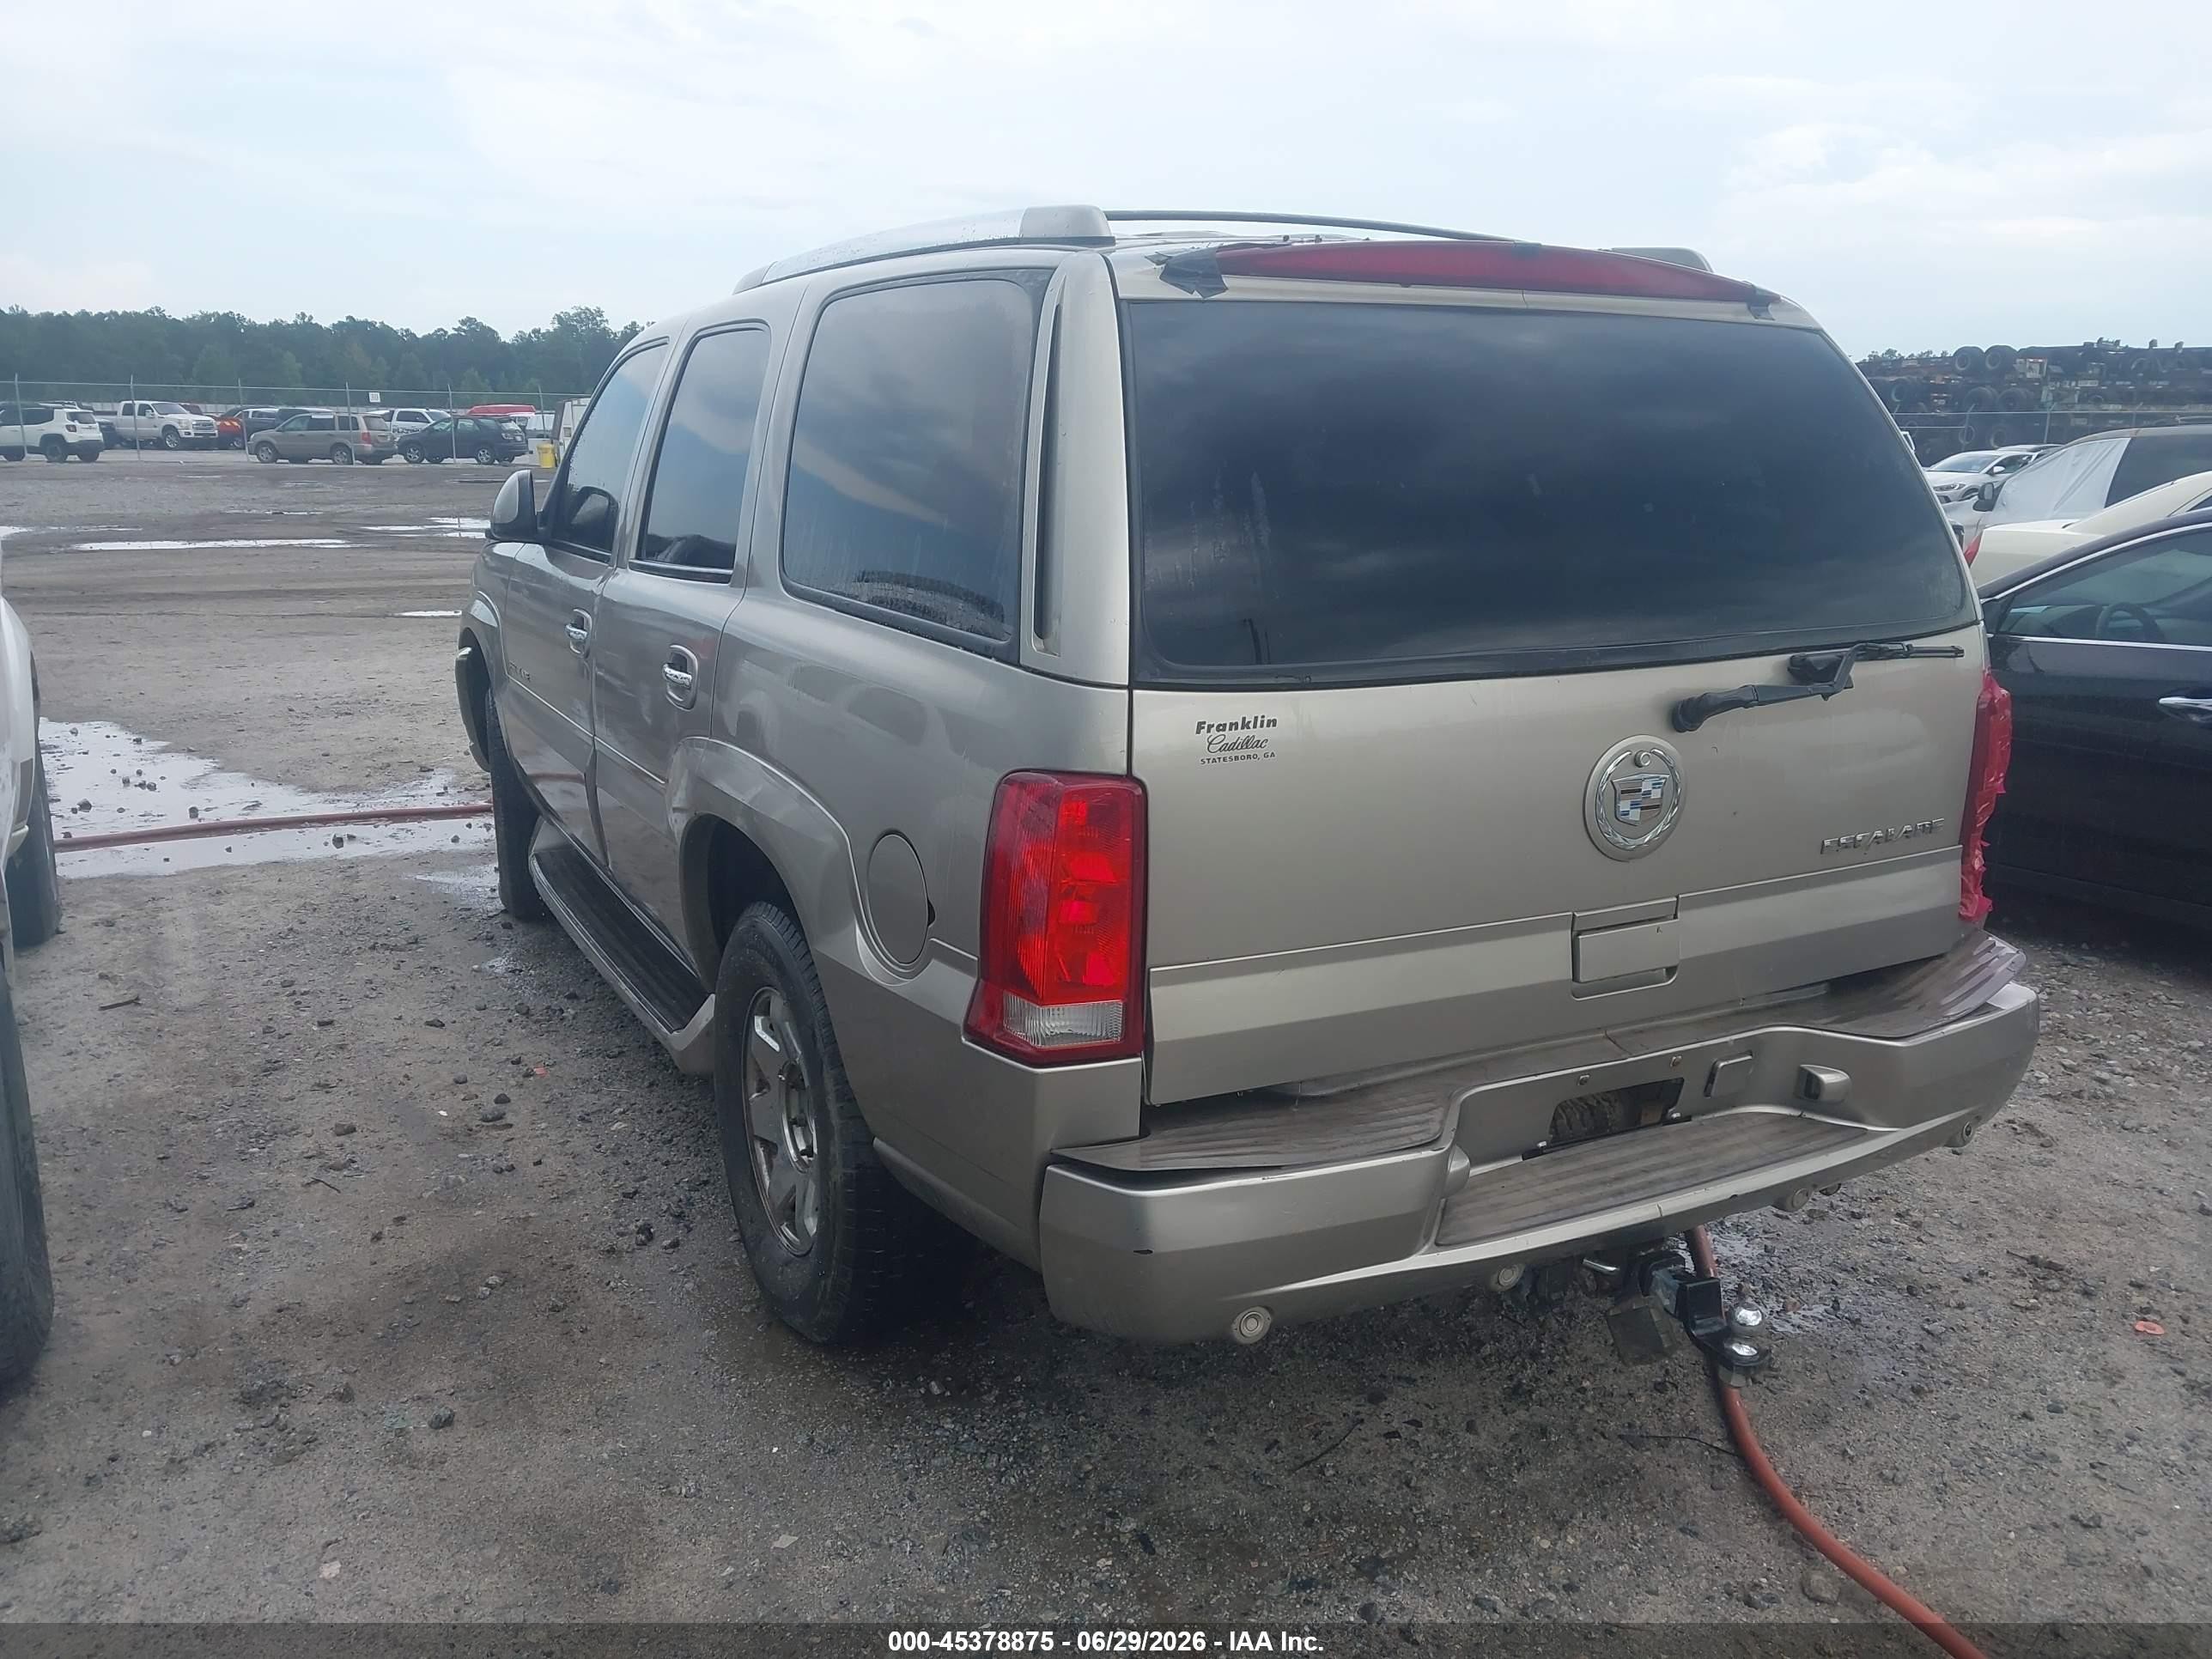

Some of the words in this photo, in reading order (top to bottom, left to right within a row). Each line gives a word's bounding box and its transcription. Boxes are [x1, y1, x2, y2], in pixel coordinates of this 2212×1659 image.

[1195, 714, 1278, 734] Franklin
[1206, 733, 1268, 753] Cadillac
[1200, 754, 1261, 764] STATESBORO,
